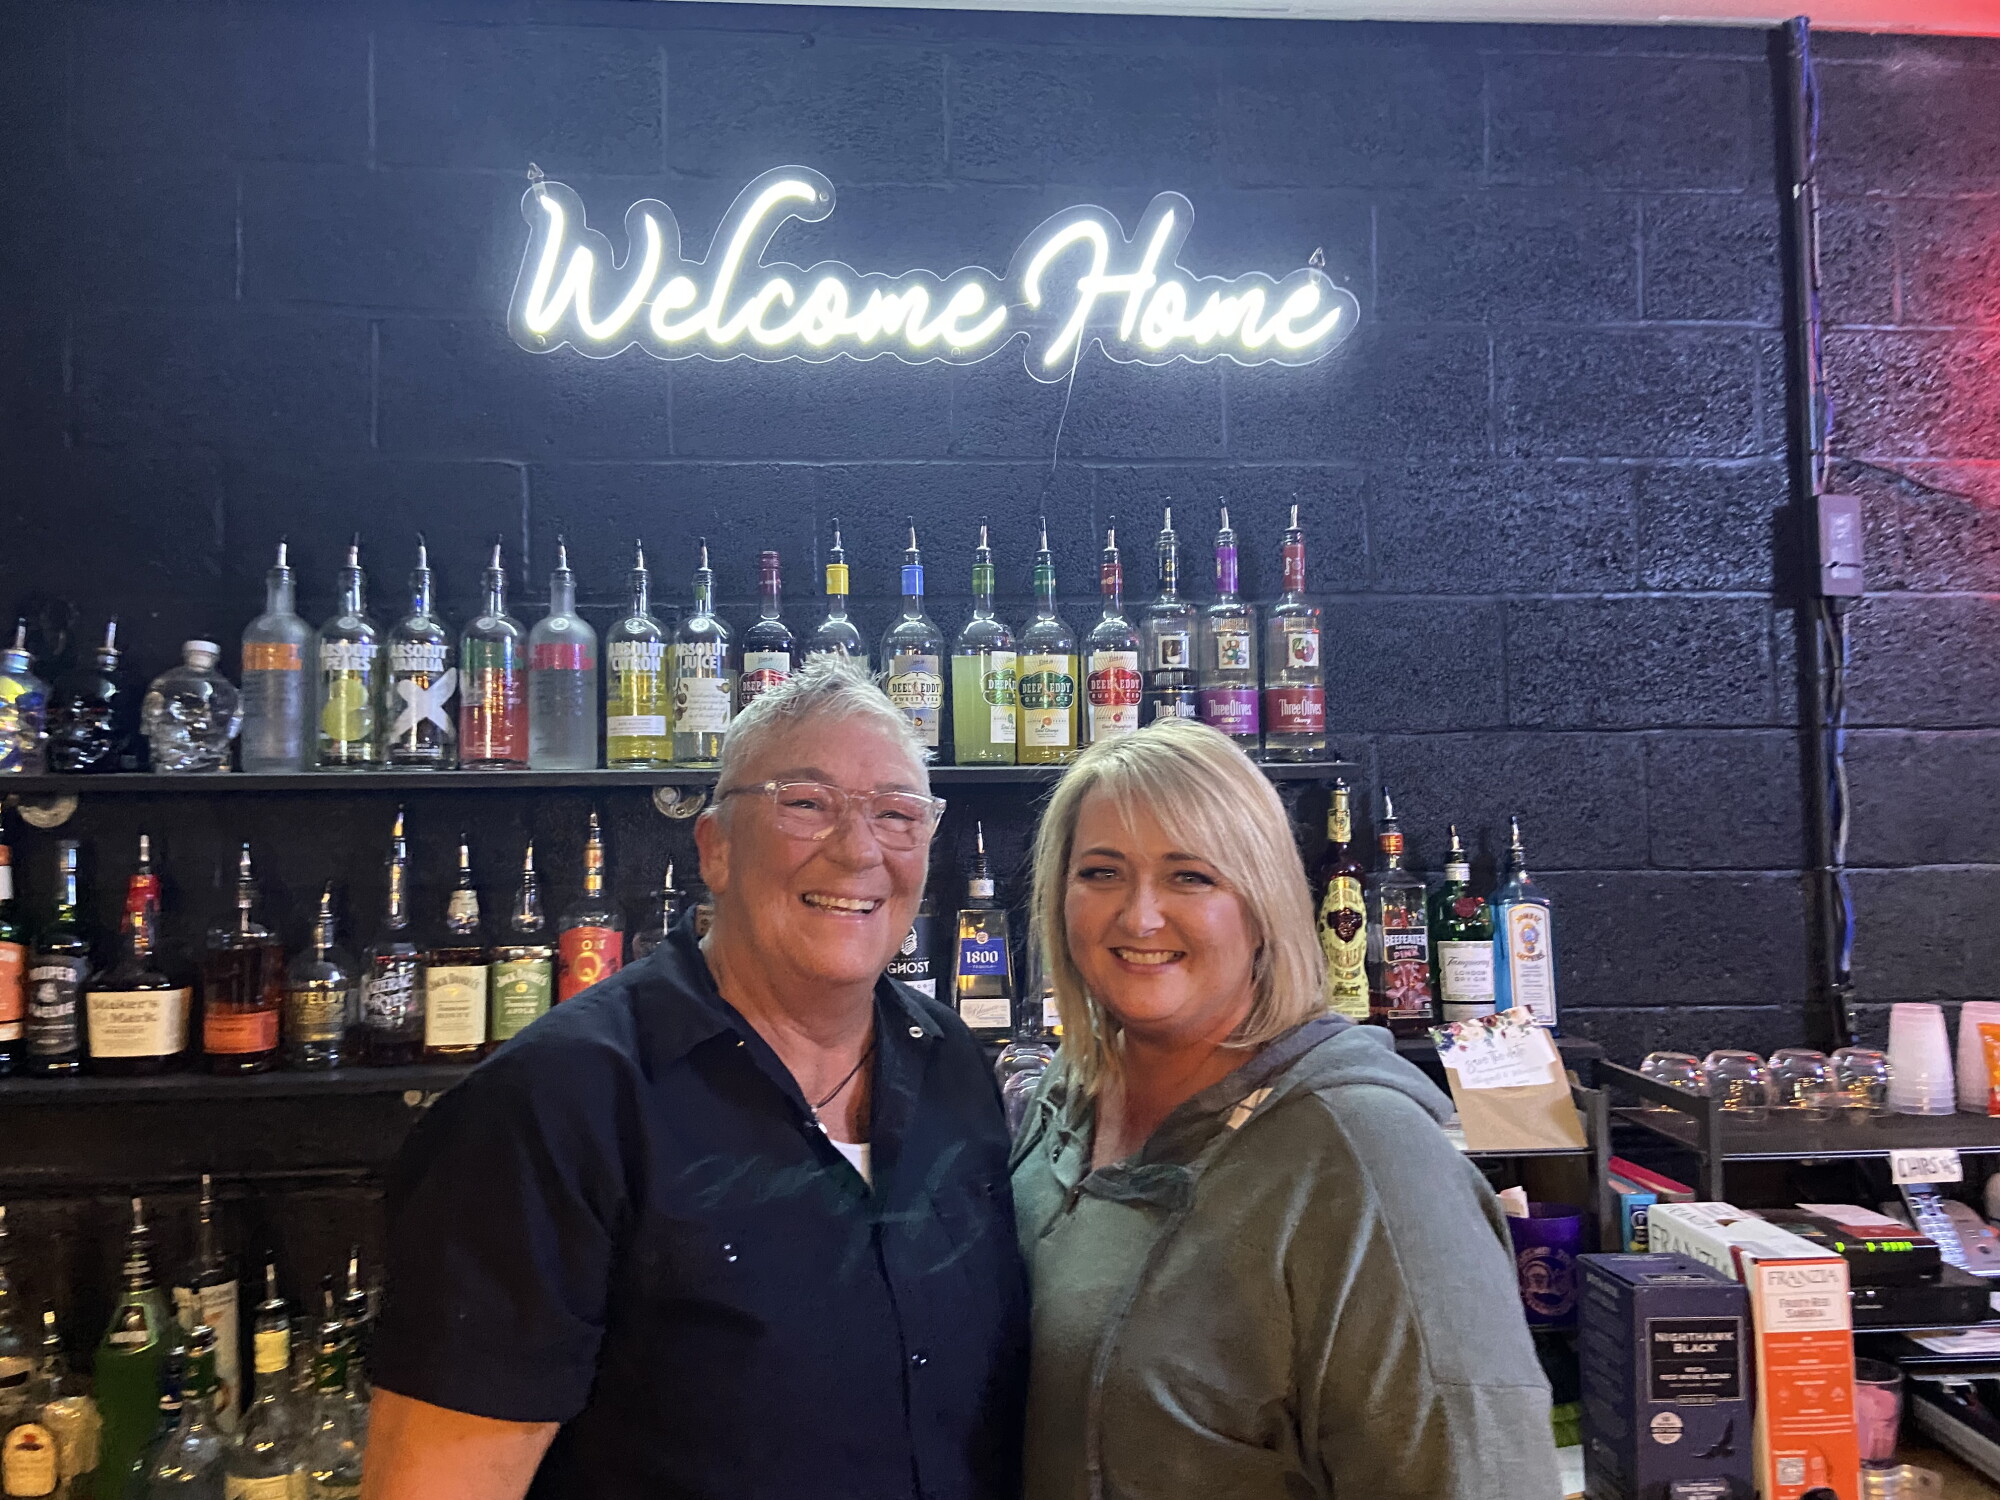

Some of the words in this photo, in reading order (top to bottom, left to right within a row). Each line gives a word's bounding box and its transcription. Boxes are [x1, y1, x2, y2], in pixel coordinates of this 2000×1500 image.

[523, 180, 1006, 348] Welcome
[1025, 207, 1342, 367] Home
[320, 643, 378, 658] ABSOLUT
[388, 643, 447, 659] ABSOLUT
[608, 642, 666, 657] ABSOLUT
[674, 642, 728, 657] ABSOLUT
[611, 657, 661, 671] CITRON
[681, 656, 717, 669] JUICE
[892, 683, 912, 692] DEEP
[920, 683, 940, 692] EDDY
[988, 680, 1009, 690] DEEP
[1022, 683, 1043, 693] DEEP
[1049, 683, 1071, 693] EDDY
[1091, 680, 1113, 690] DEEP
[1119, 680, 1140, 689] EDDY
[1154, 699, 1175, 718] Three
[1176, 699, 1196, 717] Olives
[1209, 699, 1230, 717] Three
[1230, 699, 1252, 717] Olives
[1279, 699, 1301, 717] Three
[1301, 699, 1322, 716] Olives
[1384, 934, 1428, 947] BEEFEATER
[965, 950, 999, 964] 1800
[1394, 949, 1420, 959] PINK
[887, 961, 930, 974] GHOST
[1767, 1269, 1840, 1288] FRANZIA
[1654, 1332, 1735, 1342] NIGHTHAWK
[1673, 1343, 1718, 1353] BLACK
